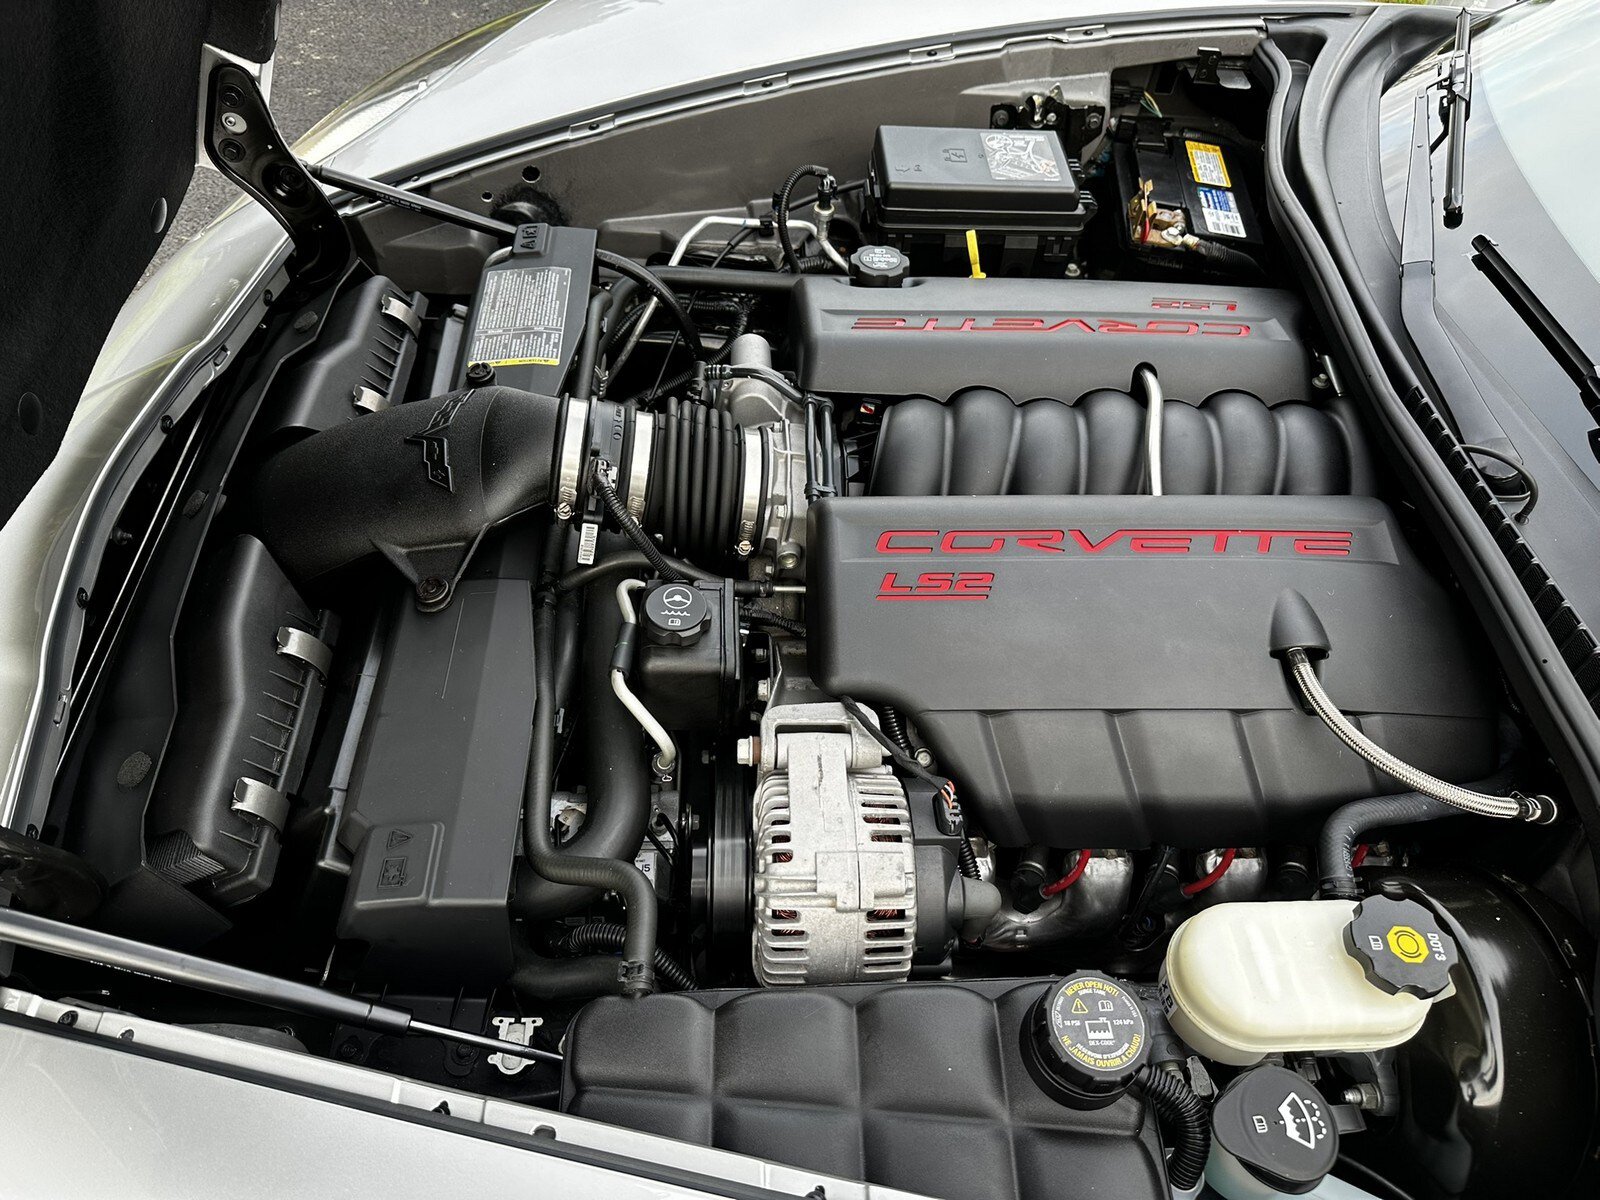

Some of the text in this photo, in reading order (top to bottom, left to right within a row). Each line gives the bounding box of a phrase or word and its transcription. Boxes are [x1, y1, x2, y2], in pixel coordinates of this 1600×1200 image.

[1151, 301, 1237, 311] LS2
[851, 317, 1250, 337] CORVETTE
[876, 529, 1353, 556] CORVETTE
[879, 572, 995, 593] LS2
[1427, 932, 1447, 962] DOT 3
[1065, 981, 1120, 997] NEVER OPEN HOT!
[1061, 1035, 1072, 1046] NE
[1069, 1046, 1095, 1065] JAMAIS
[1096, 1057, 1122, 1067] OUVRIR
[1125, 1034, 1141, 1058] CHAUD!
